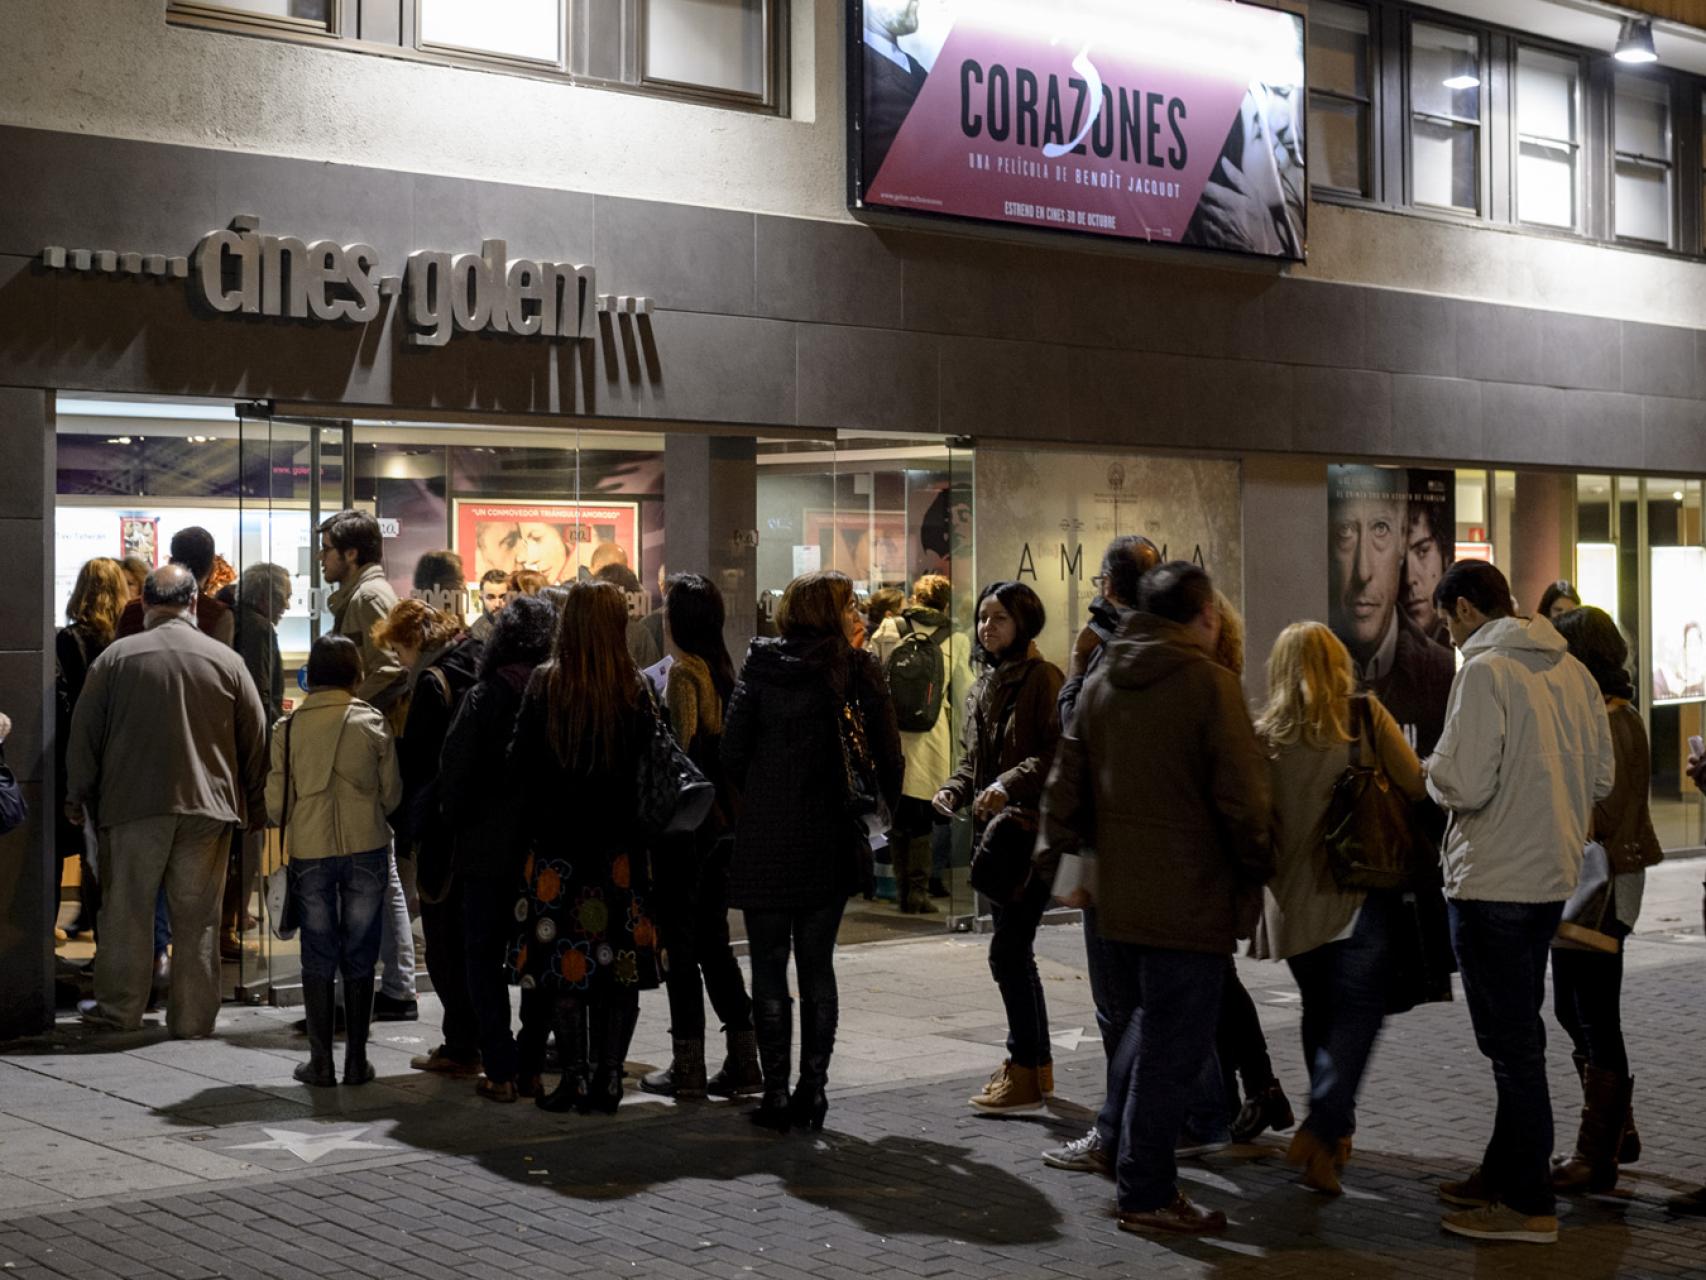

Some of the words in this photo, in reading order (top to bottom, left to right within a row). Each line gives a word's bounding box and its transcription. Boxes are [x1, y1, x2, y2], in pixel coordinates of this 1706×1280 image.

[960, 58, 1188, 171] CORAZONES
[969, 153, 990, 170] UNA
[998, 156, 1048, 179] PELÍCULA
[1056, 166, 1068, 182] DE
[1075, 168, 1121, 190] BENOÎT
[1128, 177, 1181, 199] JACQUOT
[1004, 201, 1034, 218] ESTRENO
[1036, 205, 1045, 219] EN
[1046, 206, 1065, 222] CINES
[1066, 209, 1075, 223] 30
[1077, 211, 1086, 225] DE
[1087, 212, 1117, 229] OCTUBRE
[201, 215, 380, 323] cines
[407, 239, 595, 346] golem
[488, 509, 539, 517] CONMOVEDOR
